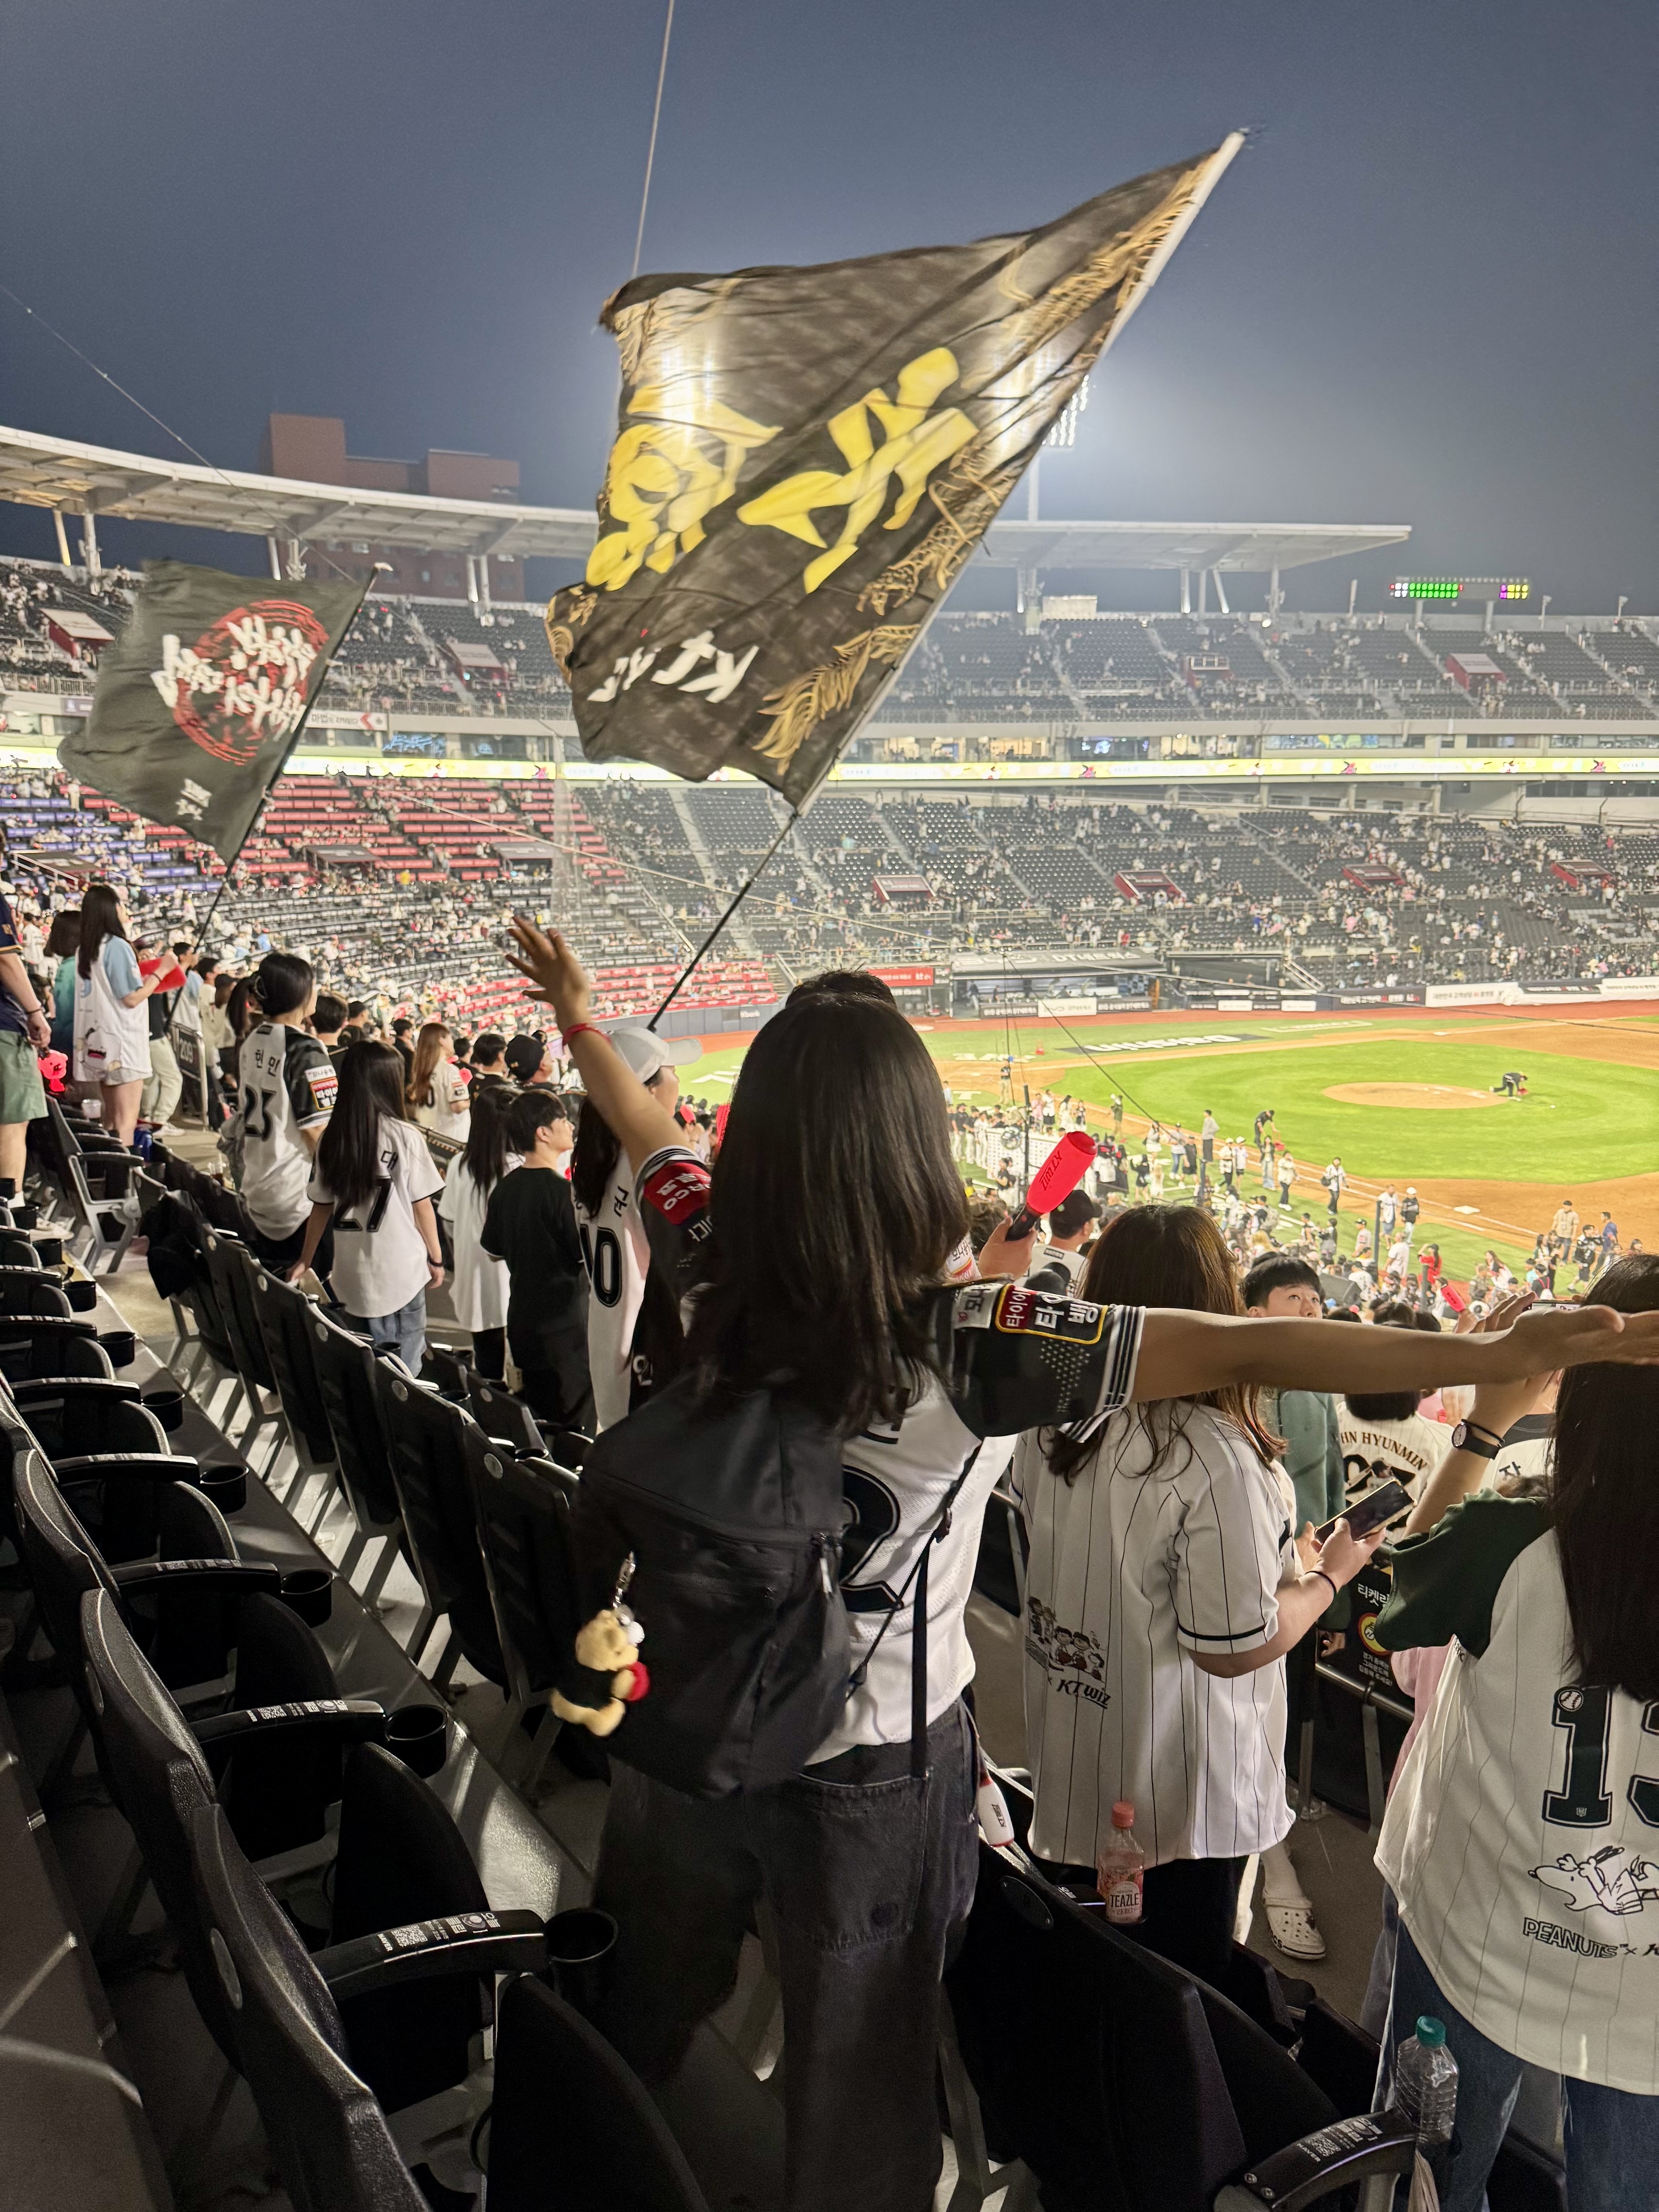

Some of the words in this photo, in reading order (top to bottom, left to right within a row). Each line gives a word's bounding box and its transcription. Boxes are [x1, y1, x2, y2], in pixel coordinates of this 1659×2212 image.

[1340, 1431, 1358, 1444] HN
[1362, 1431, 1428, 1471] HYUNMIN
[1110, 1893, 1139, 1908] TEAZLE
[377, 1933, 393, 1952] NAVER
